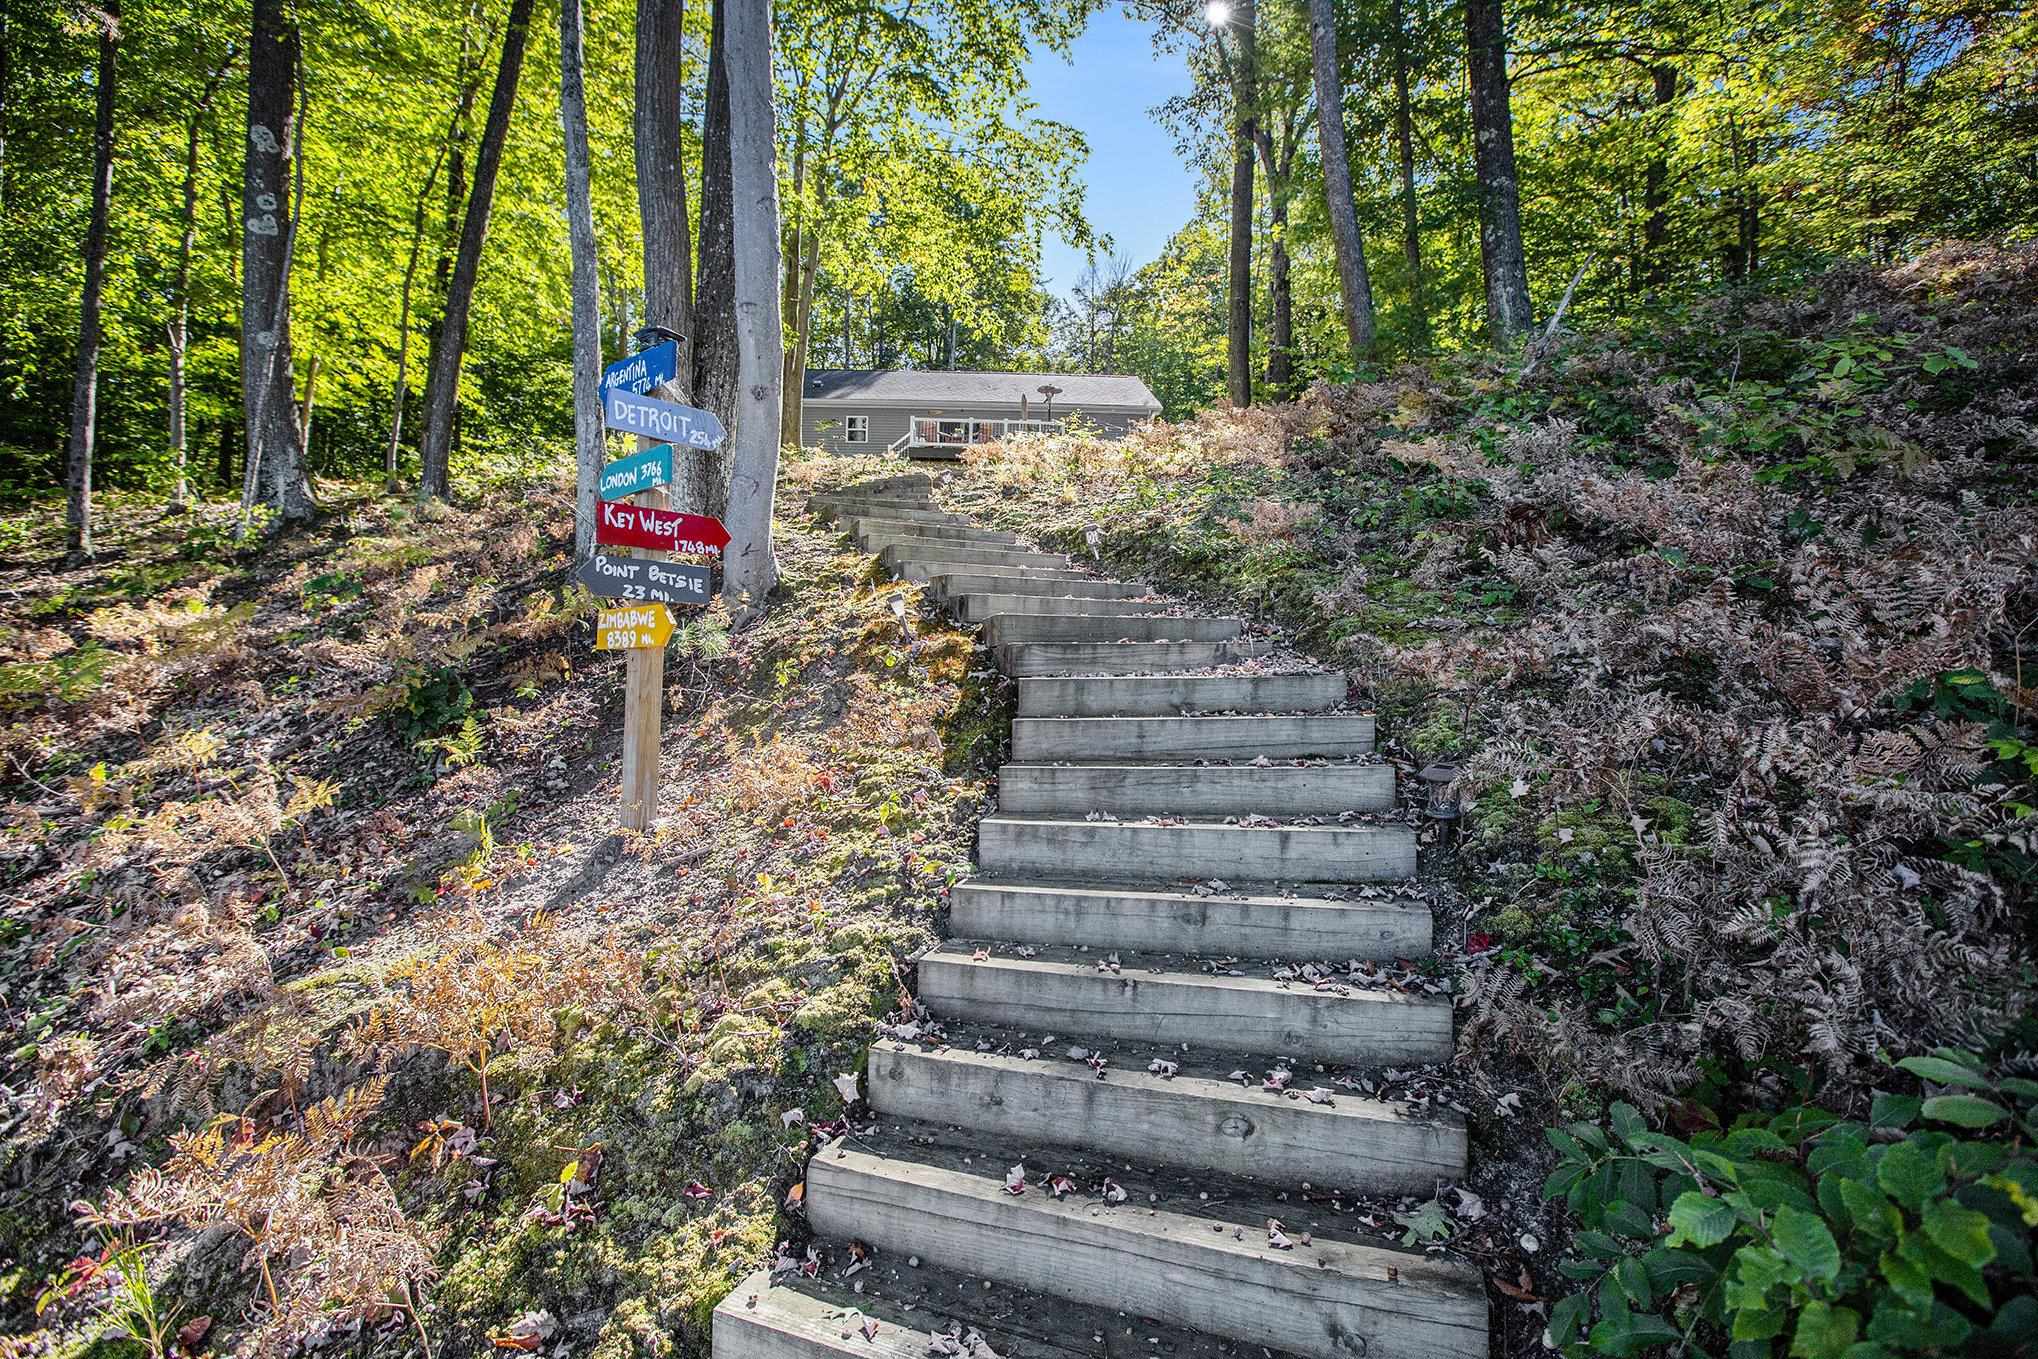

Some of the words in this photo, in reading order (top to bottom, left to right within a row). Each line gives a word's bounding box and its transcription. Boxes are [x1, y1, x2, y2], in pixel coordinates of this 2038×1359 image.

[605, 359, 647, 388] ARGENTINA
[614, 400, 691, 438] DETROIT
[600, 466, 637, 492] LONDON
[640, 460, 662, 481] 3766
[604, 503, 635, 530] KEY
[639, 510, 684, 538] WEST
[595, 555, 640, 580] POINT
[648, 565, 704, 594] BETSIE
[622, 584, 646, 600] 23
[598, 610, 656, 629] ZIMBABWE
[607, 631, 637, 647] 8389
